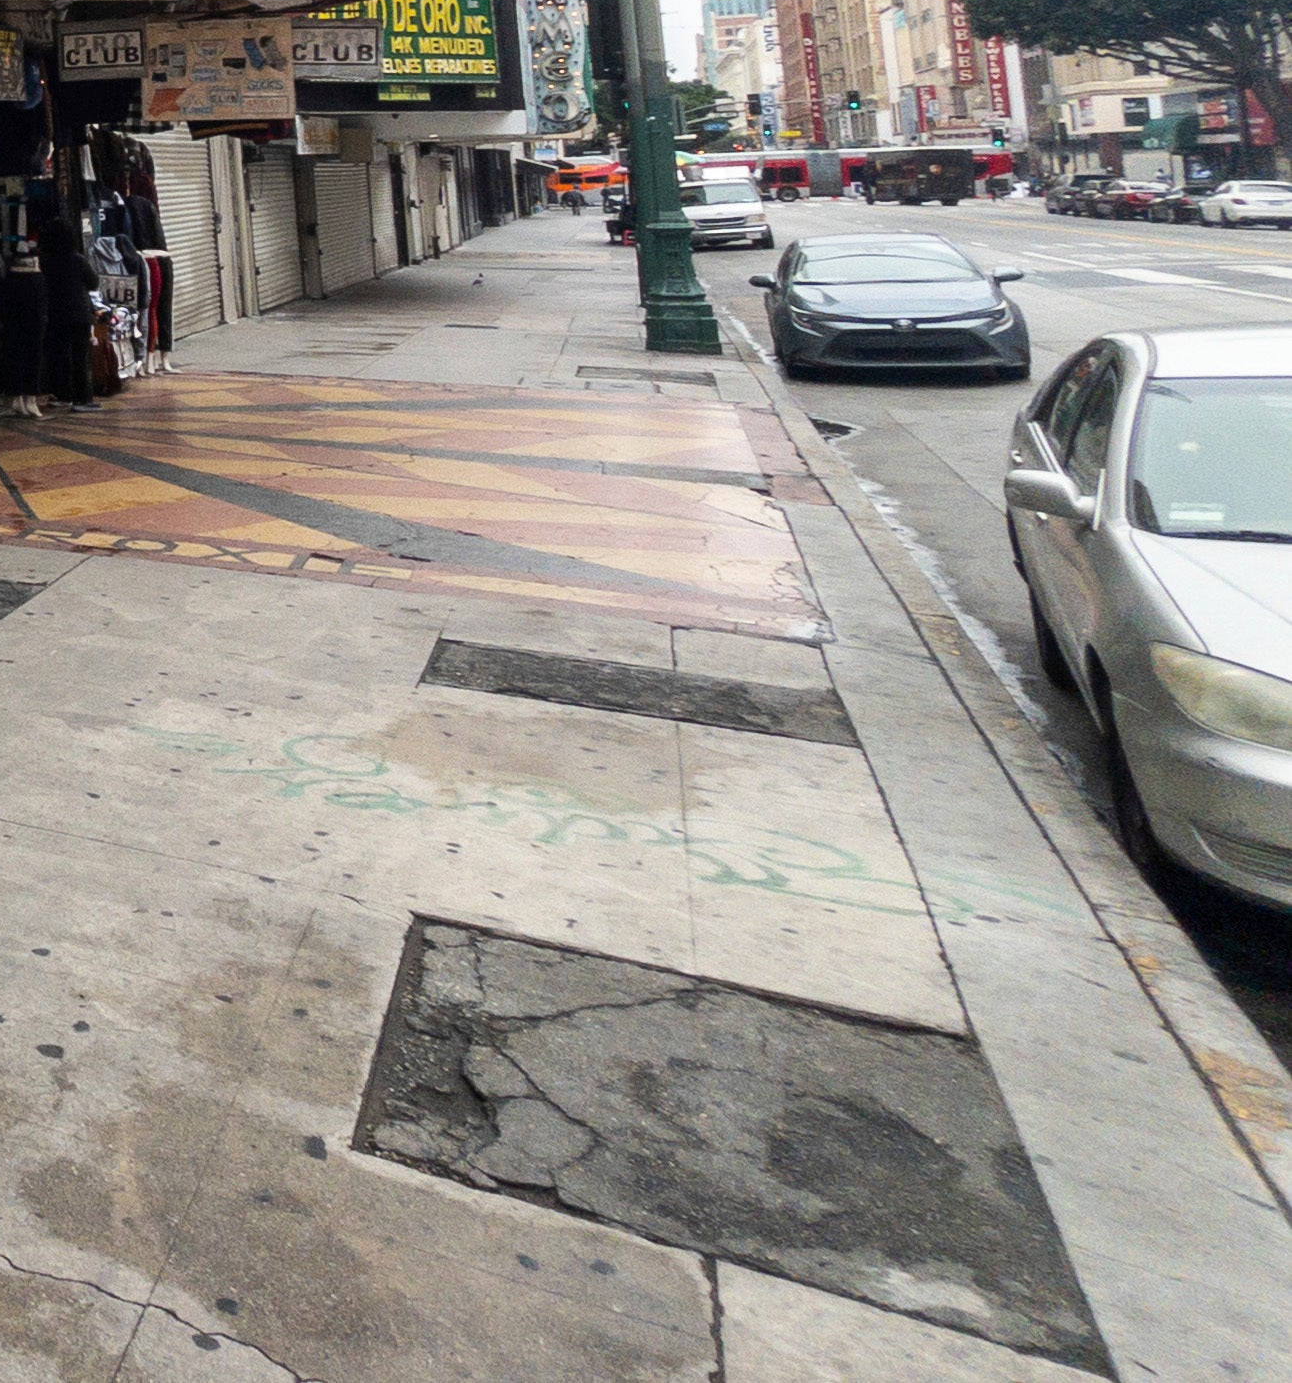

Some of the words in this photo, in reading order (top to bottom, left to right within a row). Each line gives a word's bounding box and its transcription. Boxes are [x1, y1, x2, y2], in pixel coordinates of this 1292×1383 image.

[464, 15, 492, 35] INC.
[74, 34, 131, 51] PRO
[419, 36, 486, 56] MENUDEO
[65, 46, 140, 66] CLUB
[292, 43, 374, 62] CLUB
[382, 58, 422, 74] ELOJES
[423, 58, 497, 75] REPARACIONES
